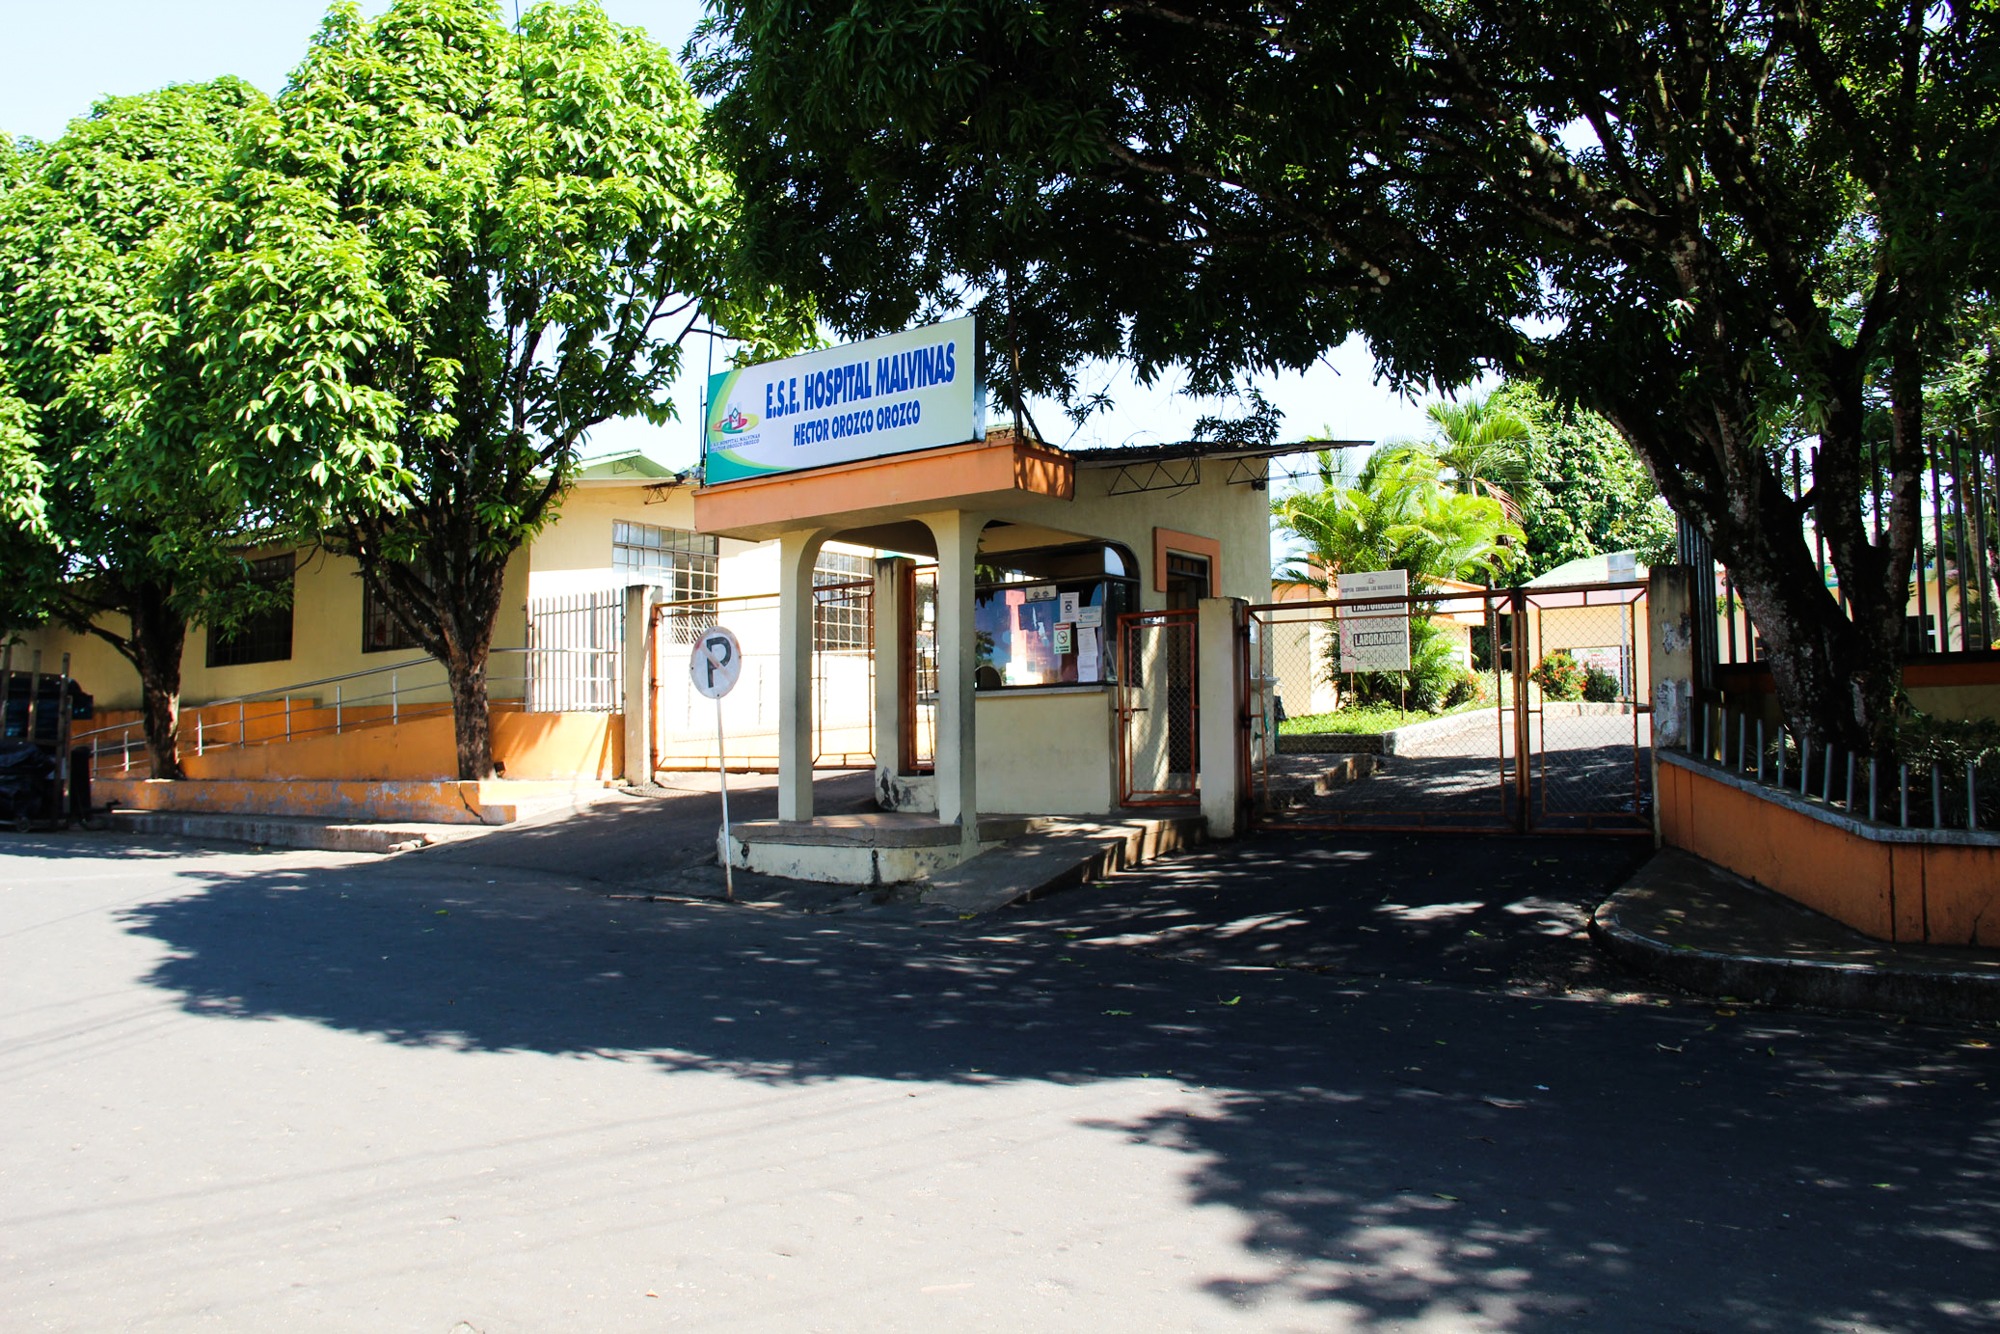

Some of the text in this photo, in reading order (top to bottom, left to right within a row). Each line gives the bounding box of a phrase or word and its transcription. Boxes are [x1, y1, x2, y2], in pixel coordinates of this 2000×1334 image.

[766, 342, 955, 419] E.S.E. HOSPITAL MALVINAS
[793, 399, 920, 447] HECTOR OROZCO OROZCO
[706, 636, 732, 688] P
[1355, 632, 1405, 645] LABORATORIO
